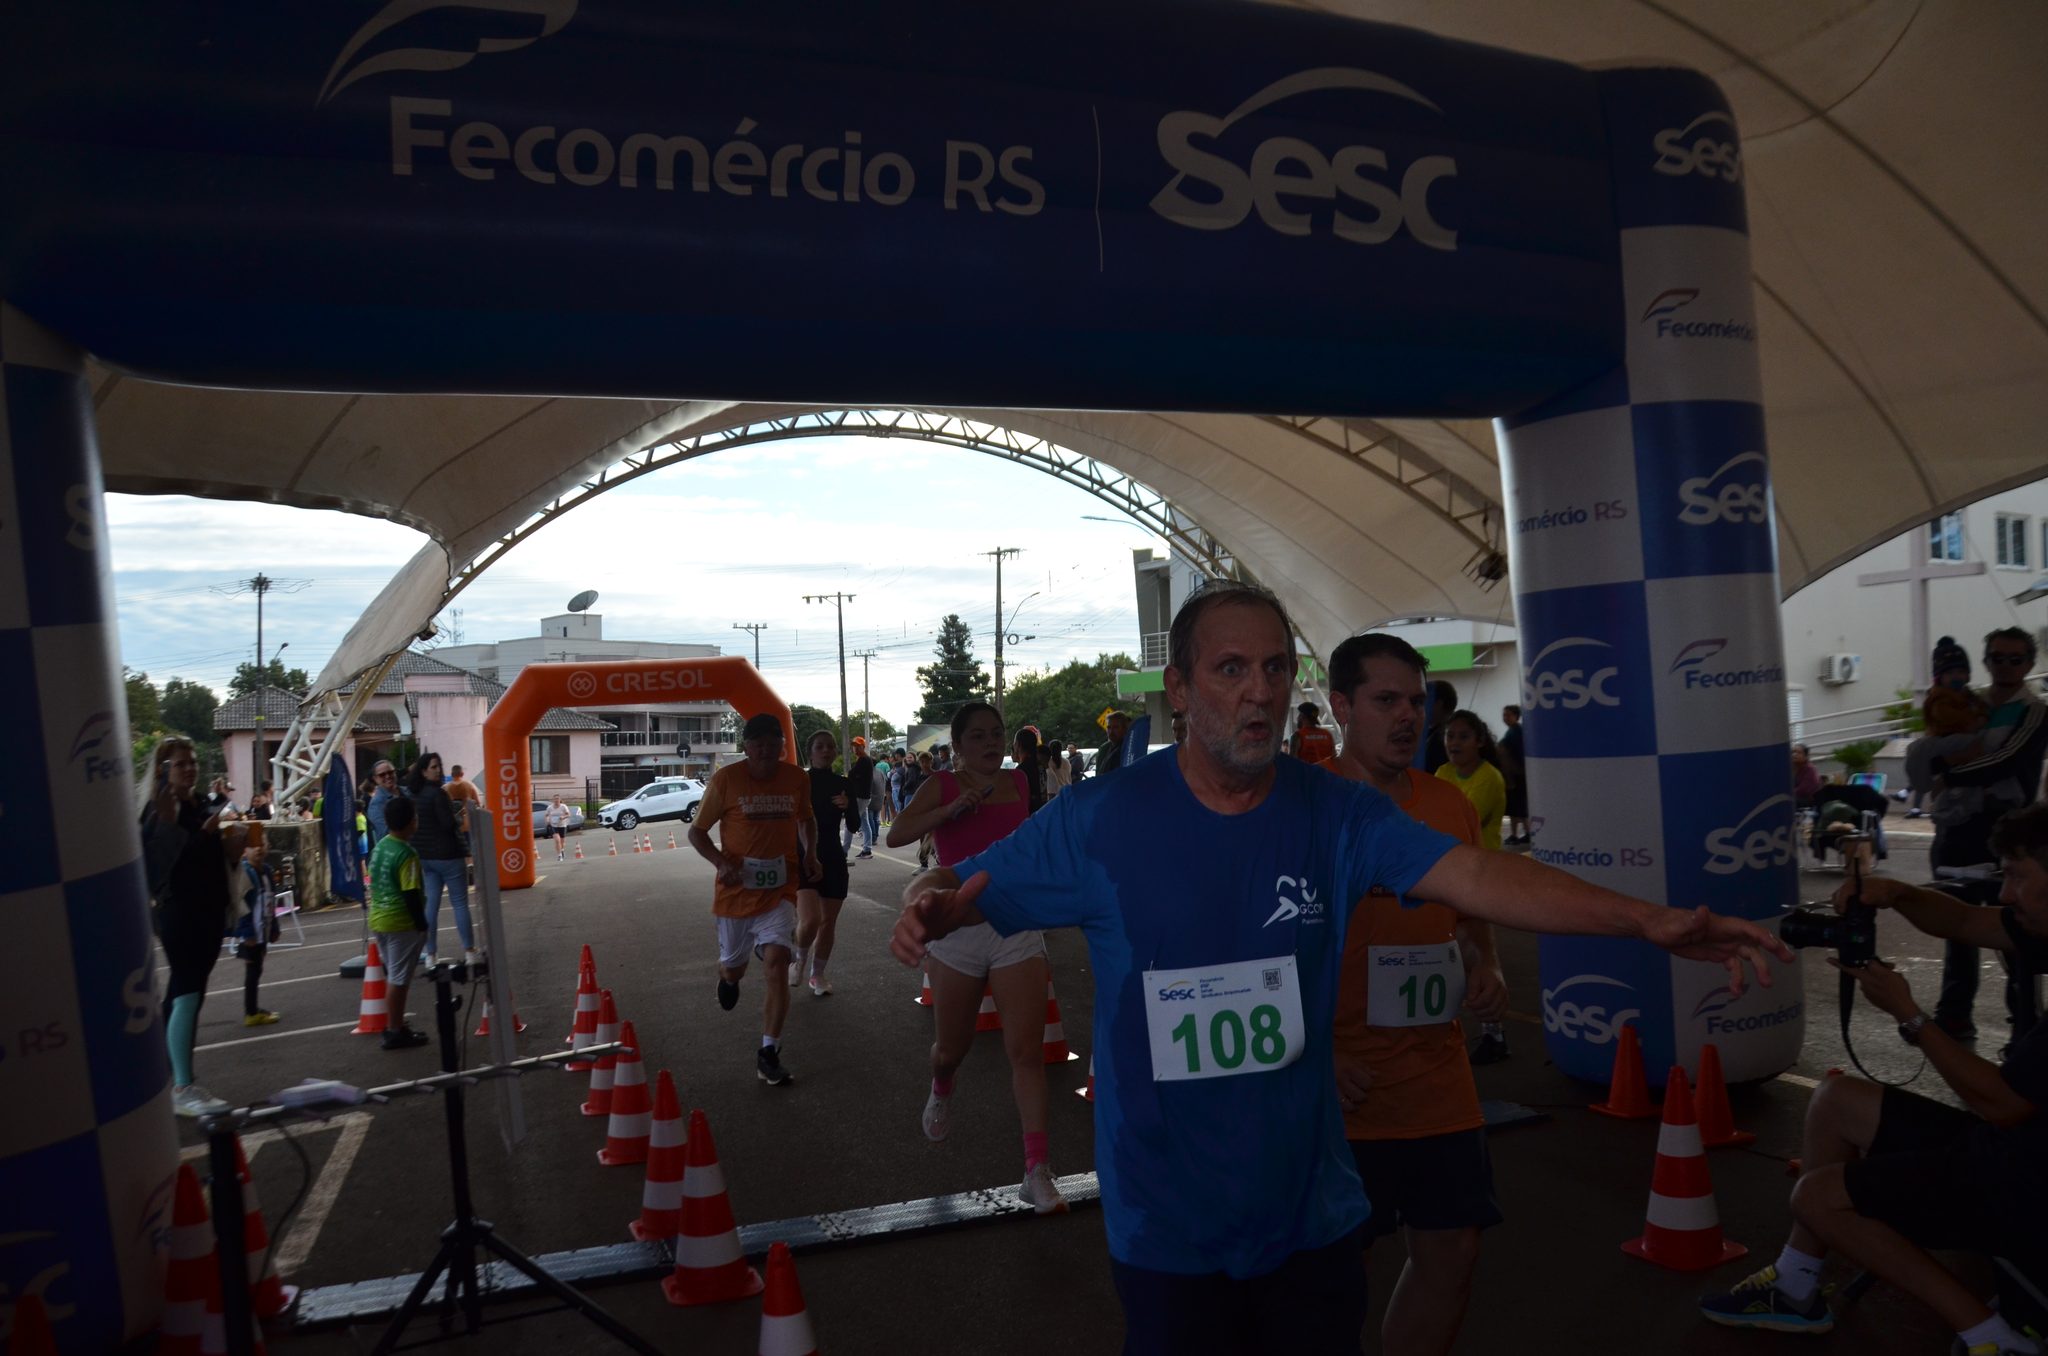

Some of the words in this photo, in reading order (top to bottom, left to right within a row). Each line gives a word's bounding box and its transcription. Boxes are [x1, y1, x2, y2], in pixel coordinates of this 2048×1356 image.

[389, 95, 916, 206] Fecomércio
[943, 139, 1046, 216] RS
[1652, 126, 1741, 183] Ses
[1149, 108, 1458, 252] Sesc
[1519, 506, 1588, 533] omércio
[1594, 500, 1628, 521] RS
[1678, 476, 1767, 525] Ses
[606, 668, 712, 694] CRESOL
[499, 750, 521, 841] CRESOL
[1620, 848, 1654, 867] RS
[1702, 825, 1792, 875] Ses
[755, 870, 778, 887] 99
[1378, 956, 1405, 966] Sesc
[1159, 985, 1195, 1001] Sesc
[1399, 973, 1446, 1018] 10
[18, 1021, 68, 1058] RS
[1172, 1004, 1286, 1073] 108
